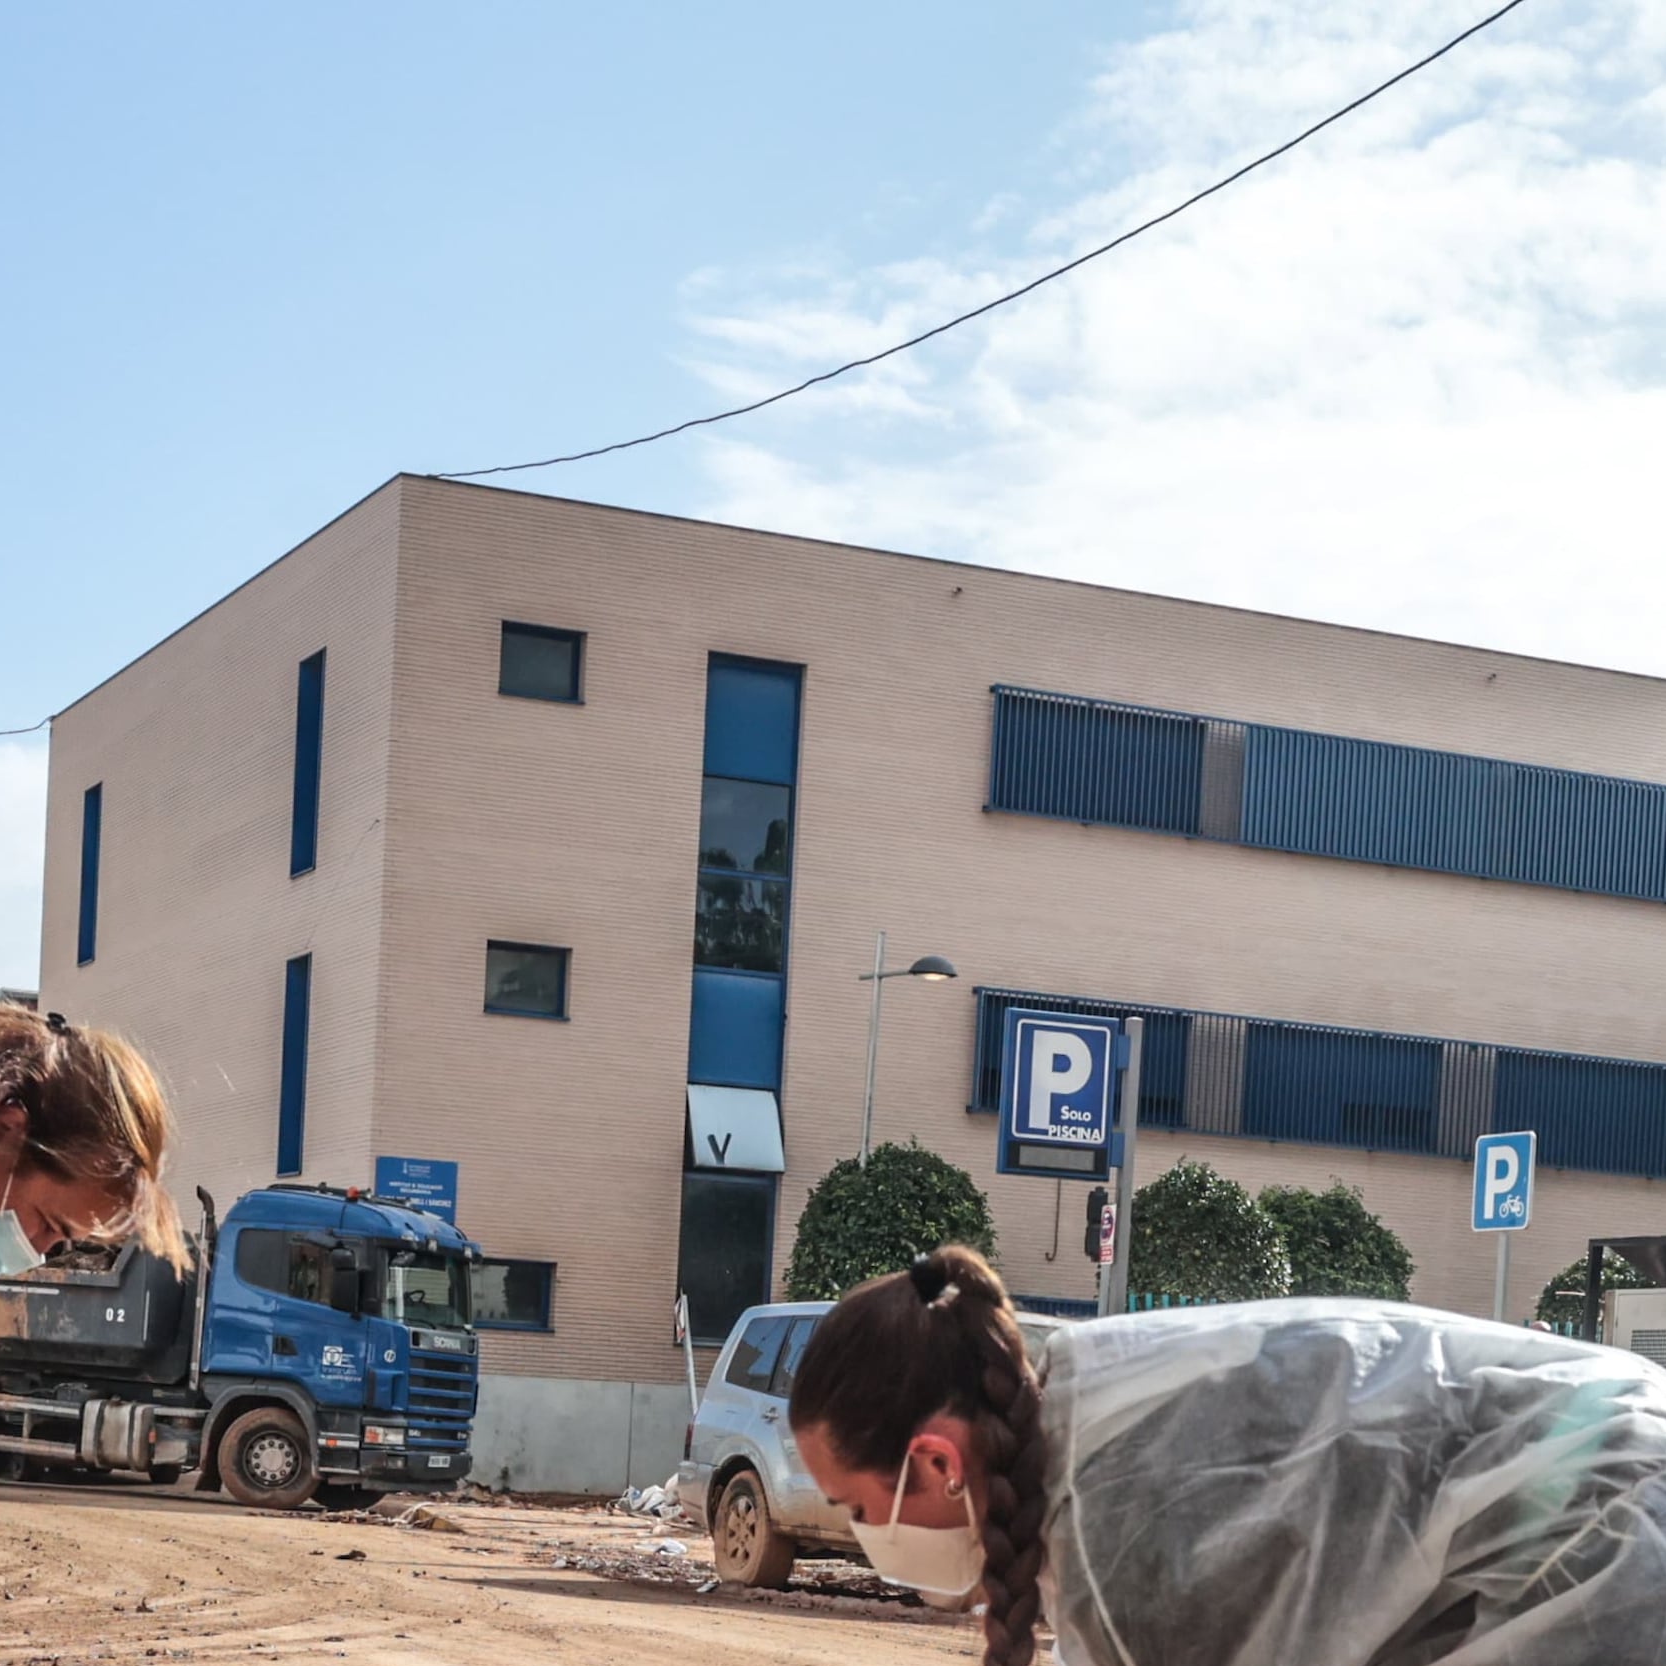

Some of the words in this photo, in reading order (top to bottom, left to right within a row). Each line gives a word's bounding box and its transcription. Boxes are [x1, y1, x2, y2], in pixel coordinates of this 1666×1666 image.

[1028, 1030, 1093, 1129] P
[1049, 1124, 1101, 1141] PISCINA
[1484, 1145, 1519, 1219] P
